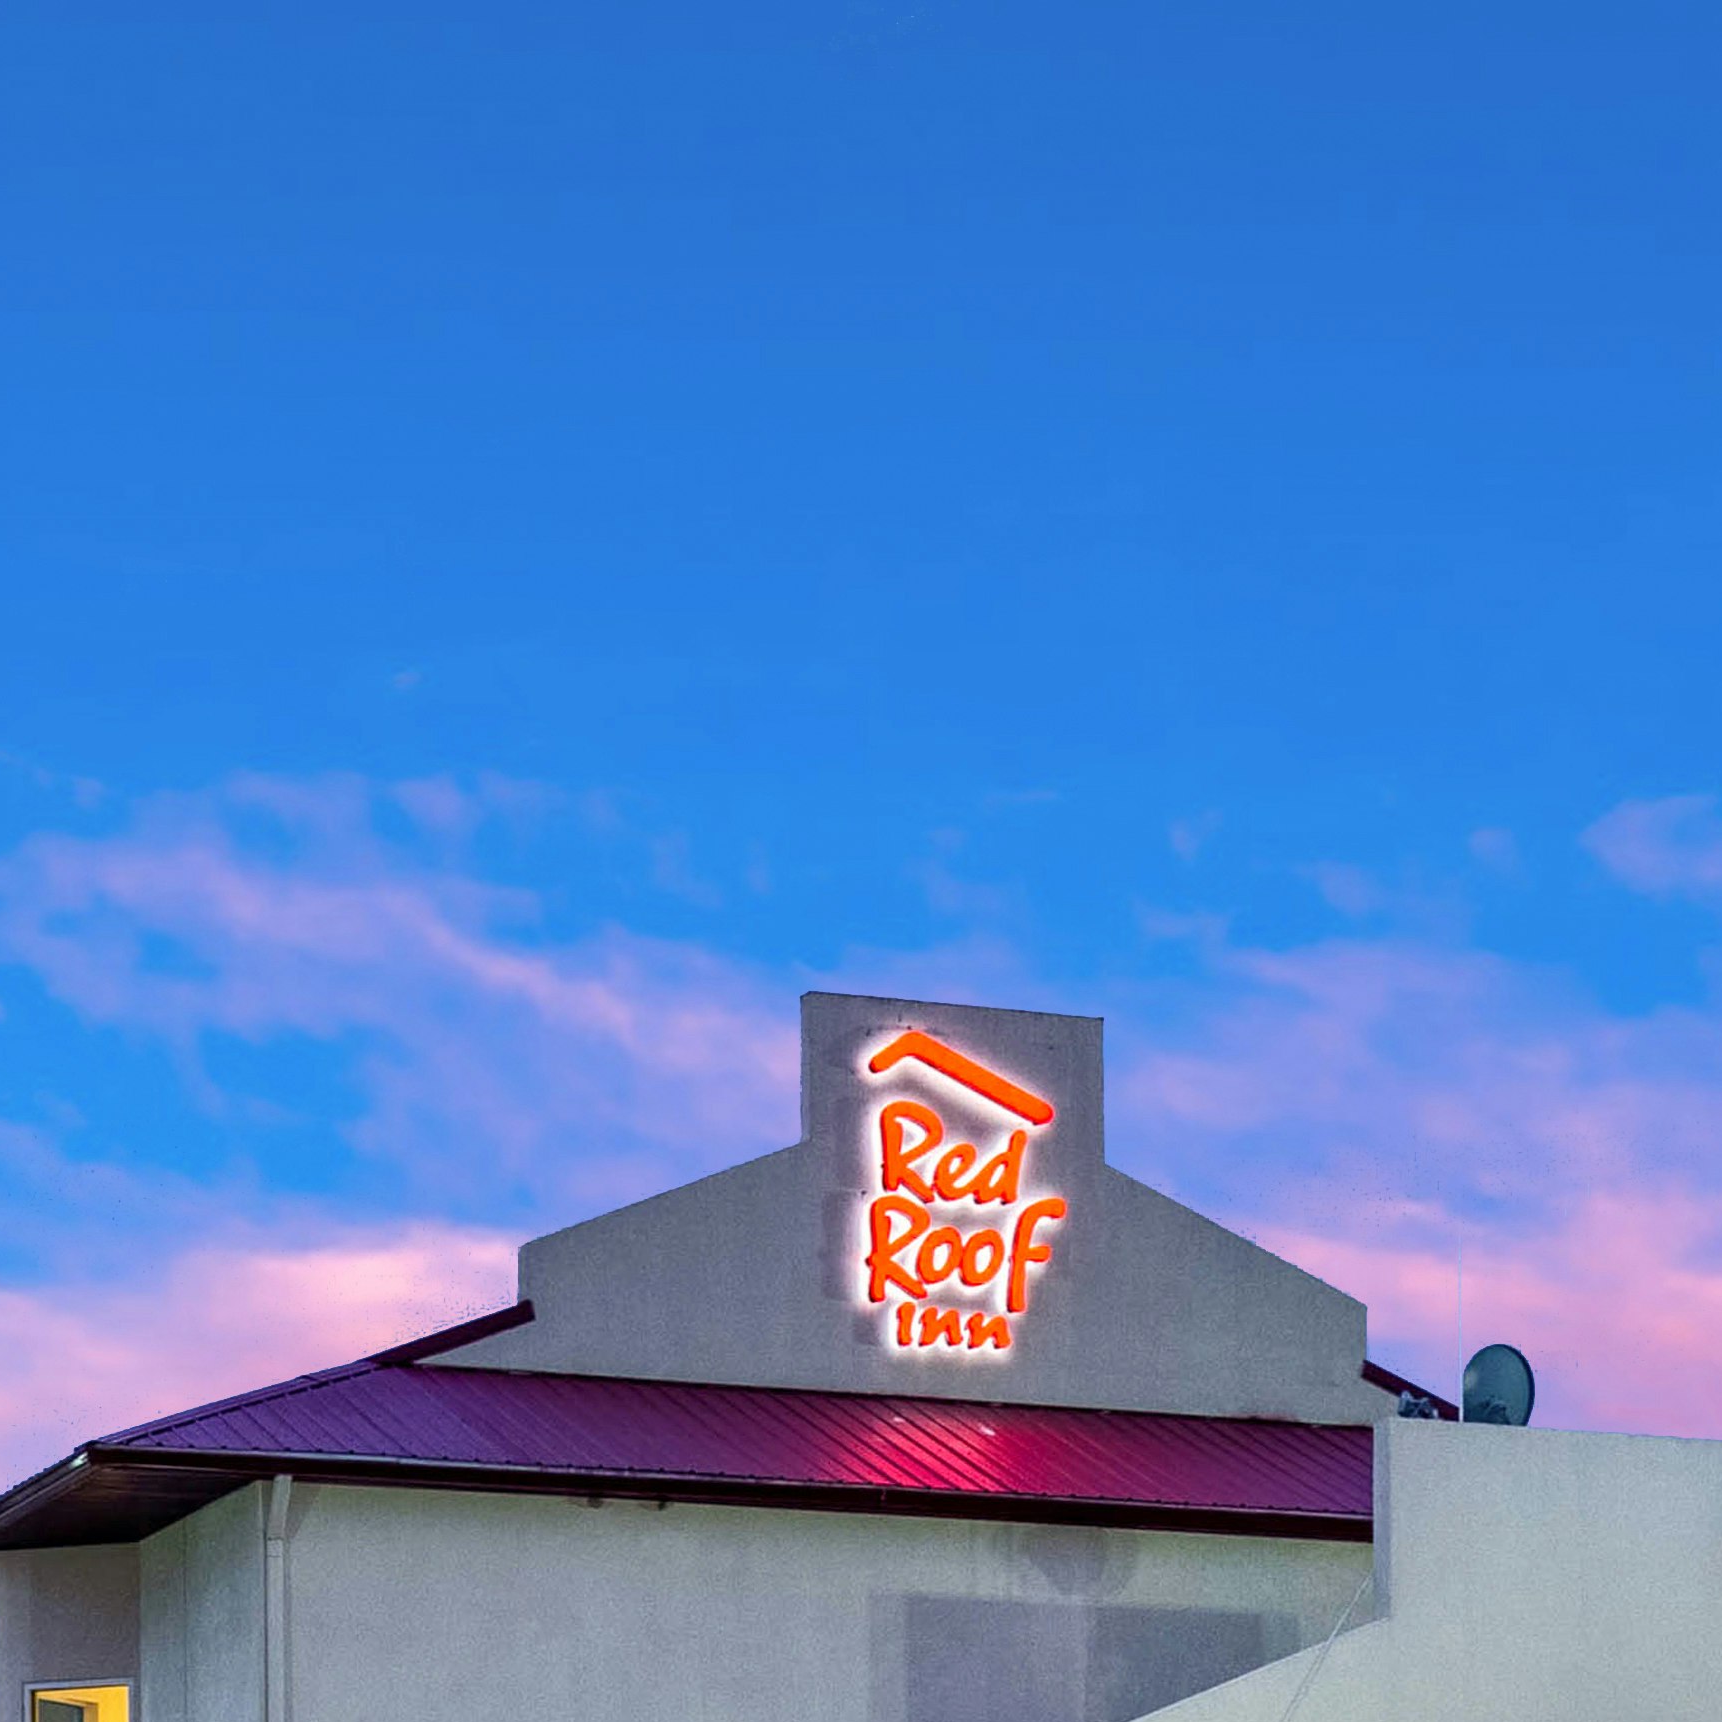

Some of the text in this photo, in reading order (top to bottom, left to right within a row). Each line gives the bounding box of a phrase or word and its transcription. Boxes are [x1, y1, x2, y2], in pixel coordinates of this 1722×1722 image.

[880, 1101, 1027, 1205] Red
[866, 1195, 1068, 1313] Roof
[896, 1301, 1014, 1349] Inn
